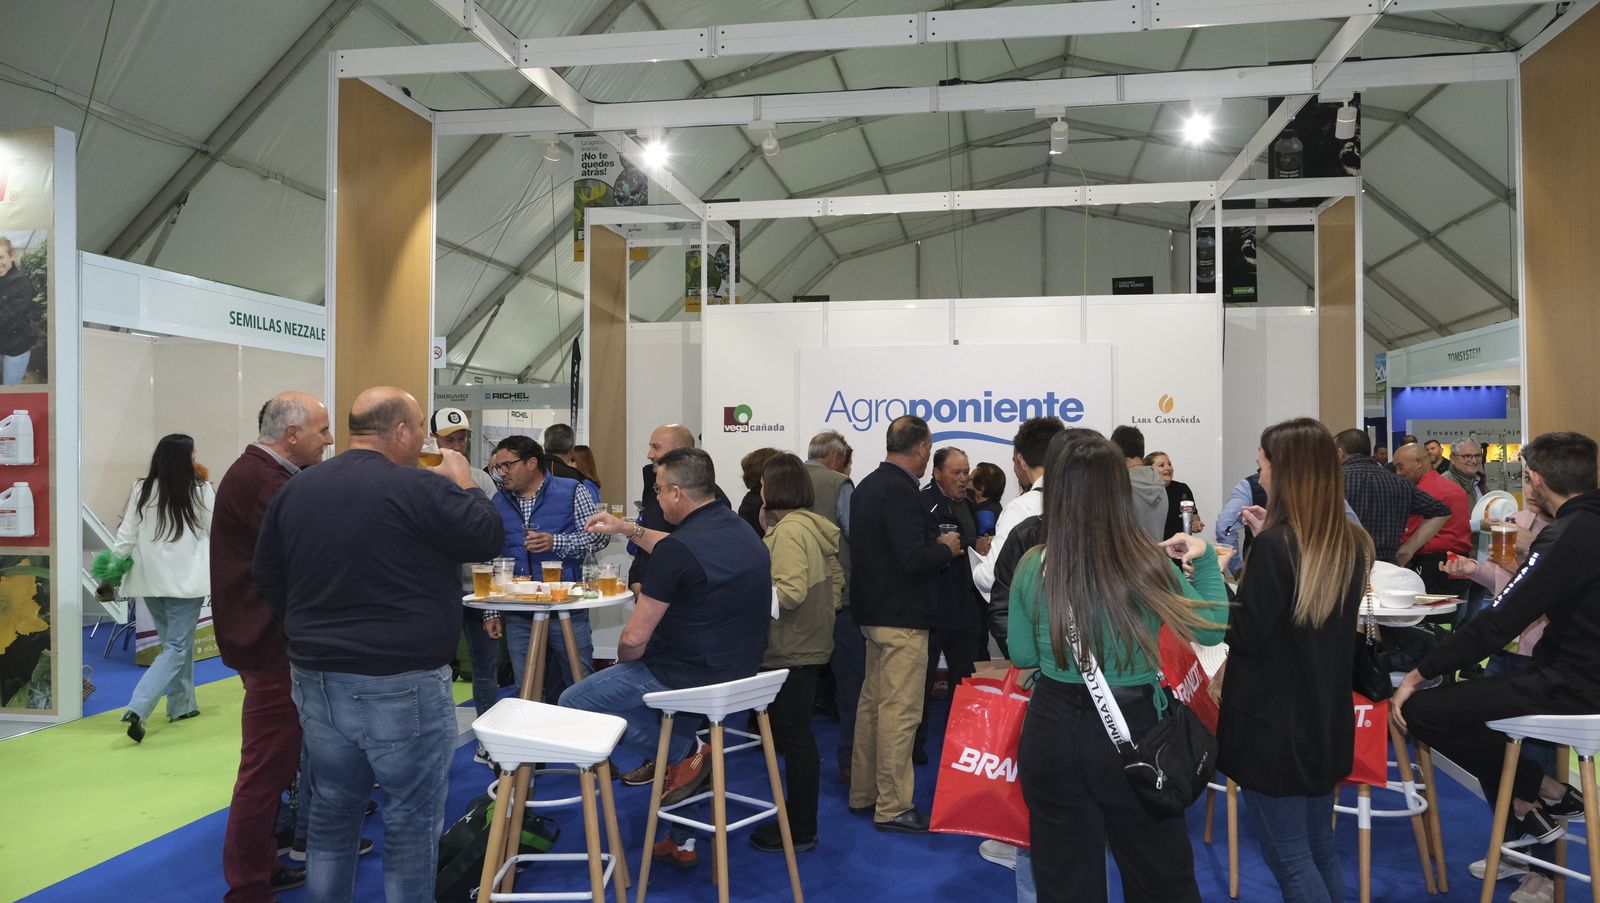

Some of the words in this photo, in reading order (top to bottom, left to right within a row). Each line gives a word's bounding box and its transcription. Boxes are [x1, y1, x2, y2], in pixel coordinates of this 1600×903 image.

[581, 152, 597, 161] ¡No
[581, 160, 615, 169] quedes
[581, 168, 607, 176] atrás!
[229, 310, 282, 333] SEMILLAS
[1447, 346, 1481, 362] TOMSYSTEM
[511, 410, 529, 419] RICHEL
[825, 390, 1085, 432] Agroponiente
[724, 424, 748, 433] vega
[749, 423, 785, 432] cañada
